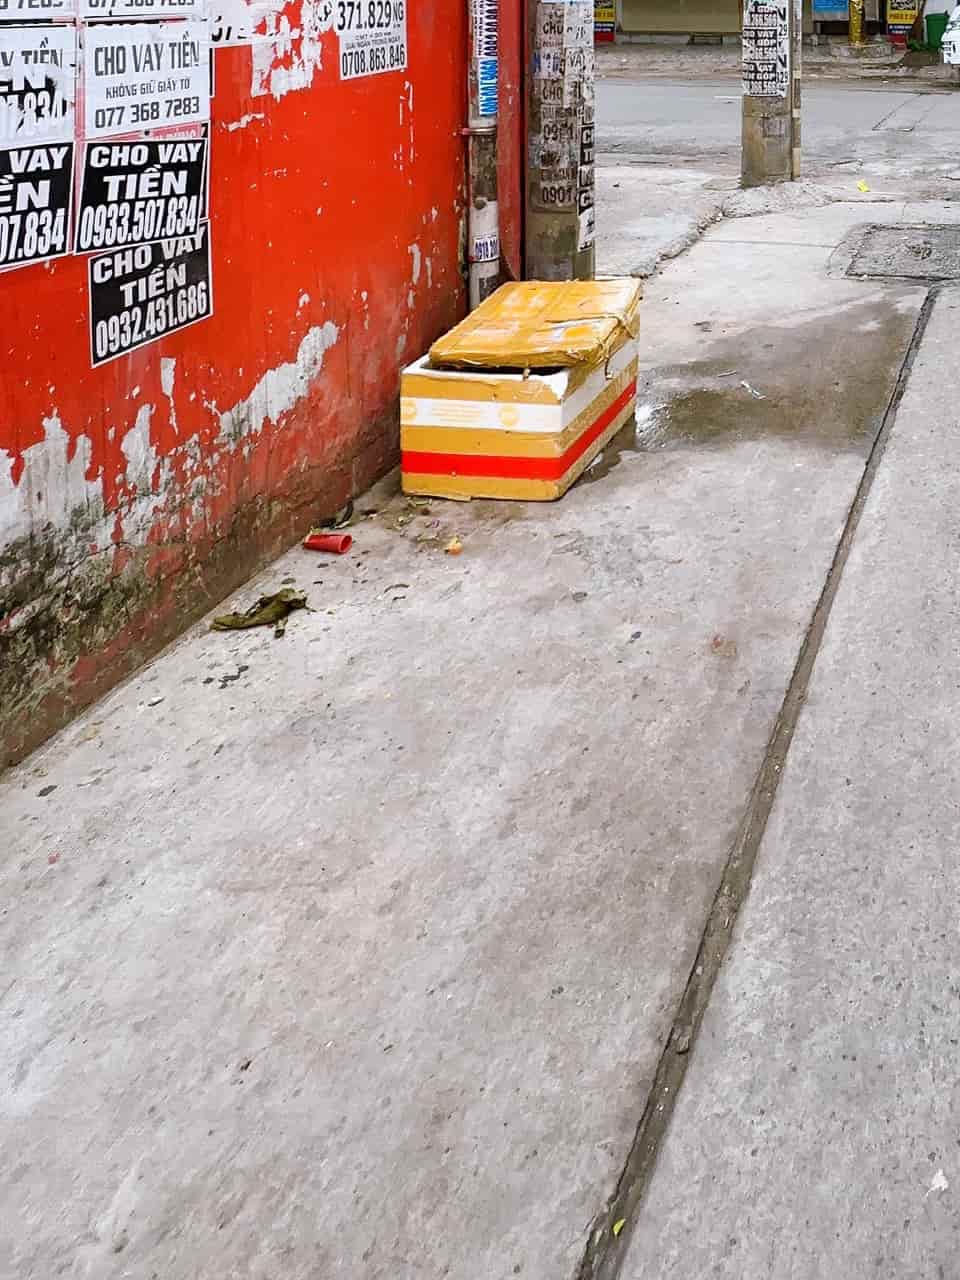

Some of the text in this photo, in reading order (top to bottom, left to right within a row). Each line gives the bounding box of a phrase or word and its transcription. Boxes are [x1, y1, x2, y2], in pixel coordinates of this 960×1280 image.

[95, 46, 126, 76] CHO
[133, 44, 164, 73] VAY
[169, 31, 199, 69] TIỀN
[343, 43, 405, 77] 0708.863.846
[95, 96, 199, 128] 077 368 7283
[9, 146, 69, 173] VAY
[90, 143, 202, 168] CHO VAY
[103, 164, 188, 202] TIỀN
[79, 195, 198, 250] 0933.507.834
[93, 245, 152, 284] CHO
[95, 281, 207, 358] 0932.431.686
